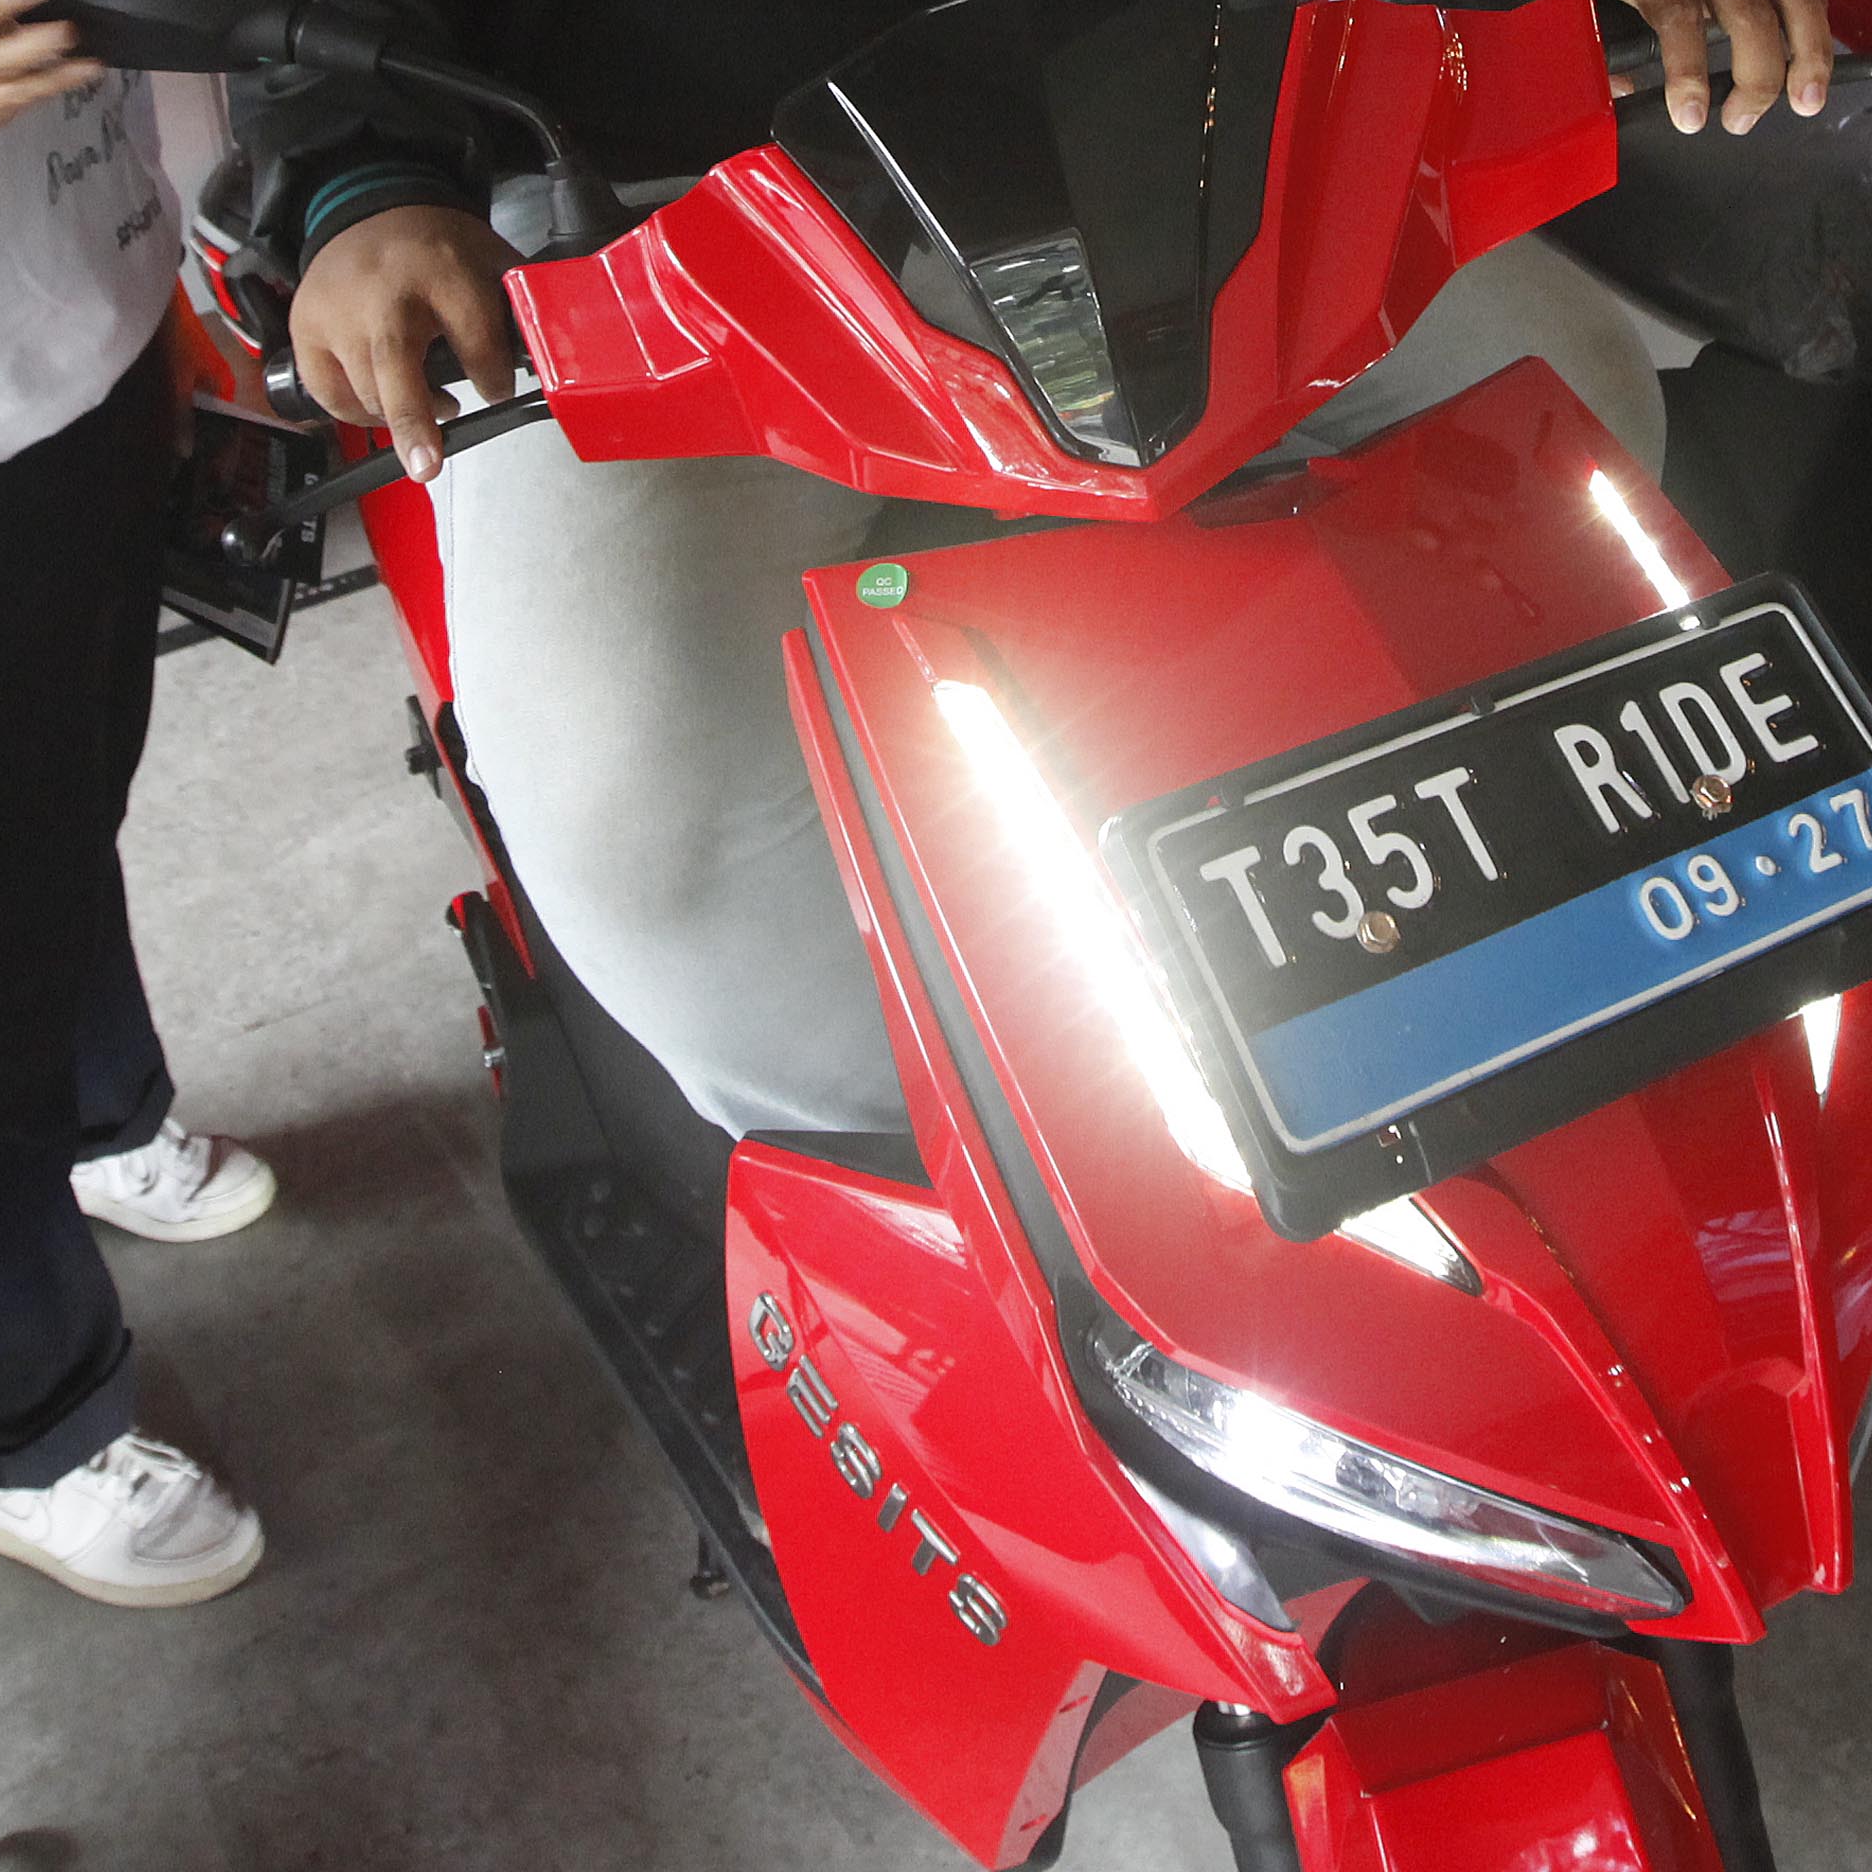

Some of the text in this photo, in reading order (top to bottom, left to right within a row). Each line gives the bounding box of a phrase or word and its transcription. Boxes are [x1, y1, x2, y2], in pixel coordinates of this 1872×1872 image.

[862, 585, 904, 597] PASSED
[876, 576, 893, 587] QC
[1199, 652, 1820, 968] T35T R1DE
[748, 1291, 1008, 1647] GESITS
